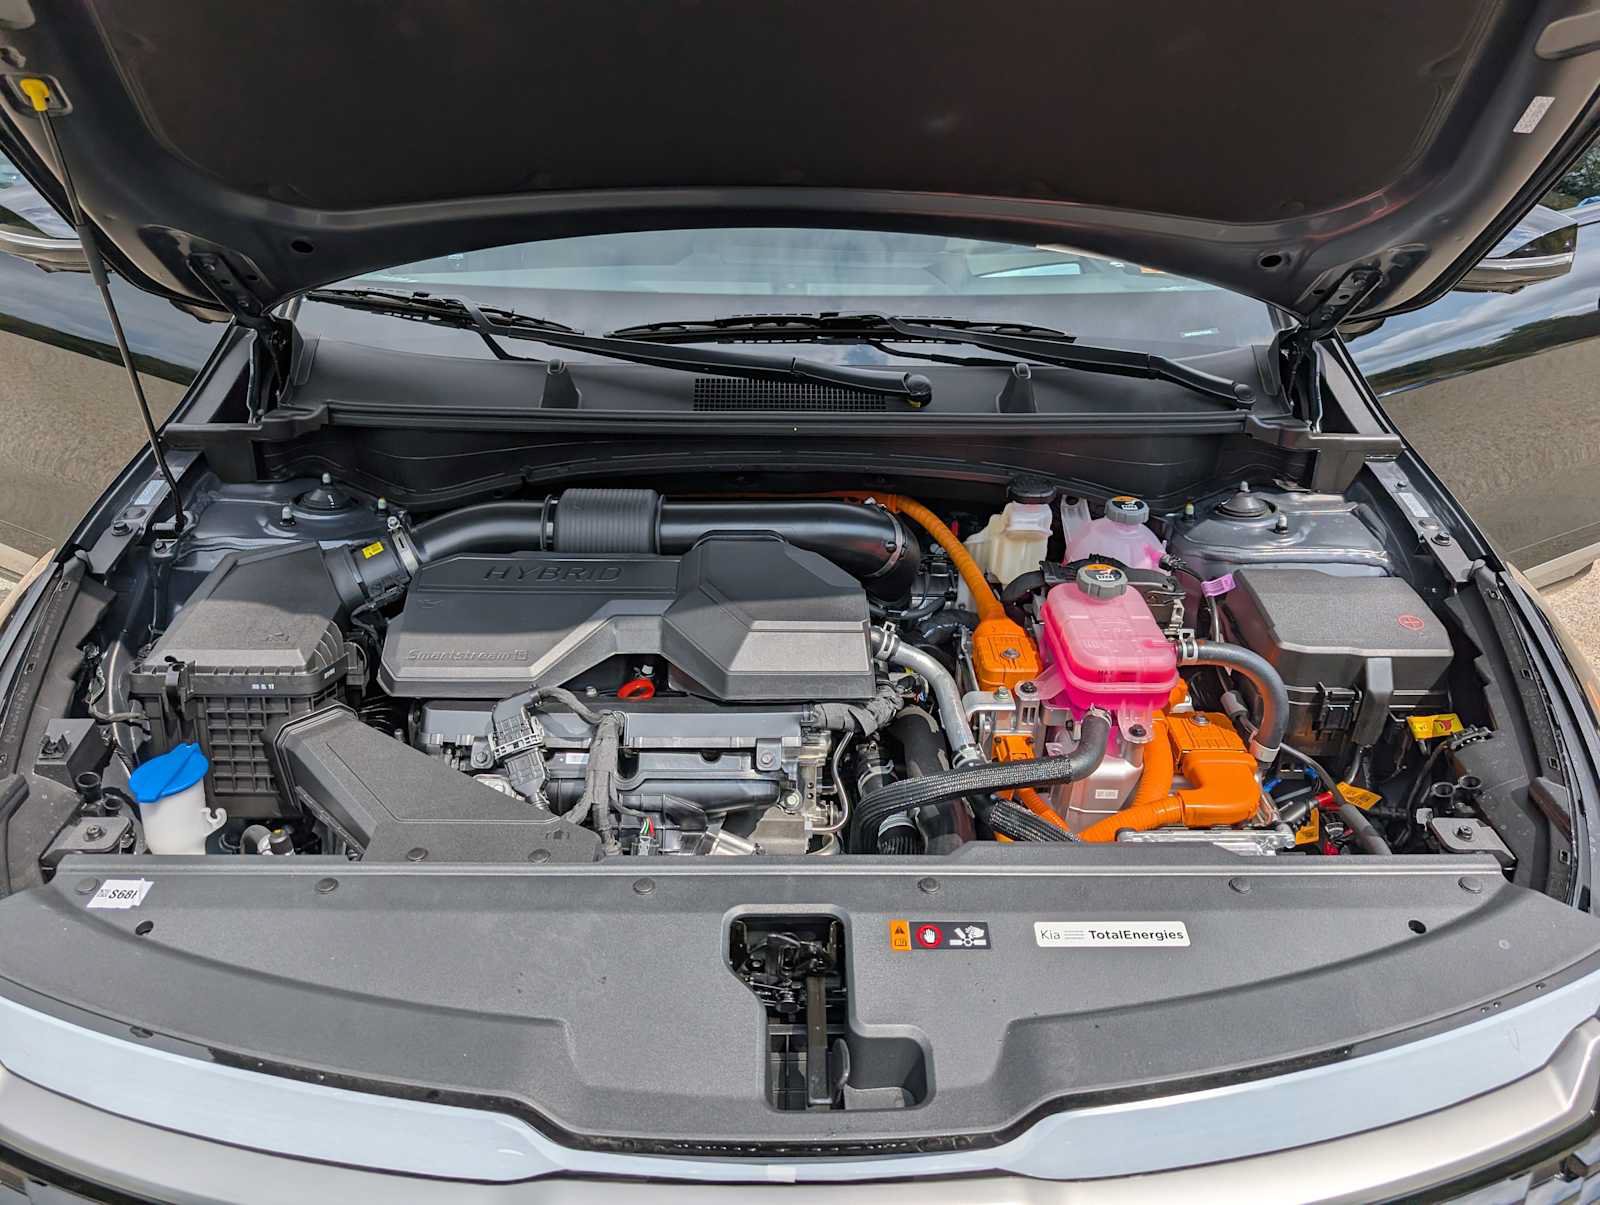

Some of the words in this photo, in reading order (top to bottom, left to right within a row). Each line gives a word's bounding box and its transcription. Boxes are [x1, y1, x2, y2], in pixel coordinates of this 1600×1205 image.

[483, 566, 623, 582] HYBRID
[407, 649, 512, 662] Smartstream
[1040, 929, 1061, 940] Kia
[1088, 930, 1184, 941] TotalEnergies
